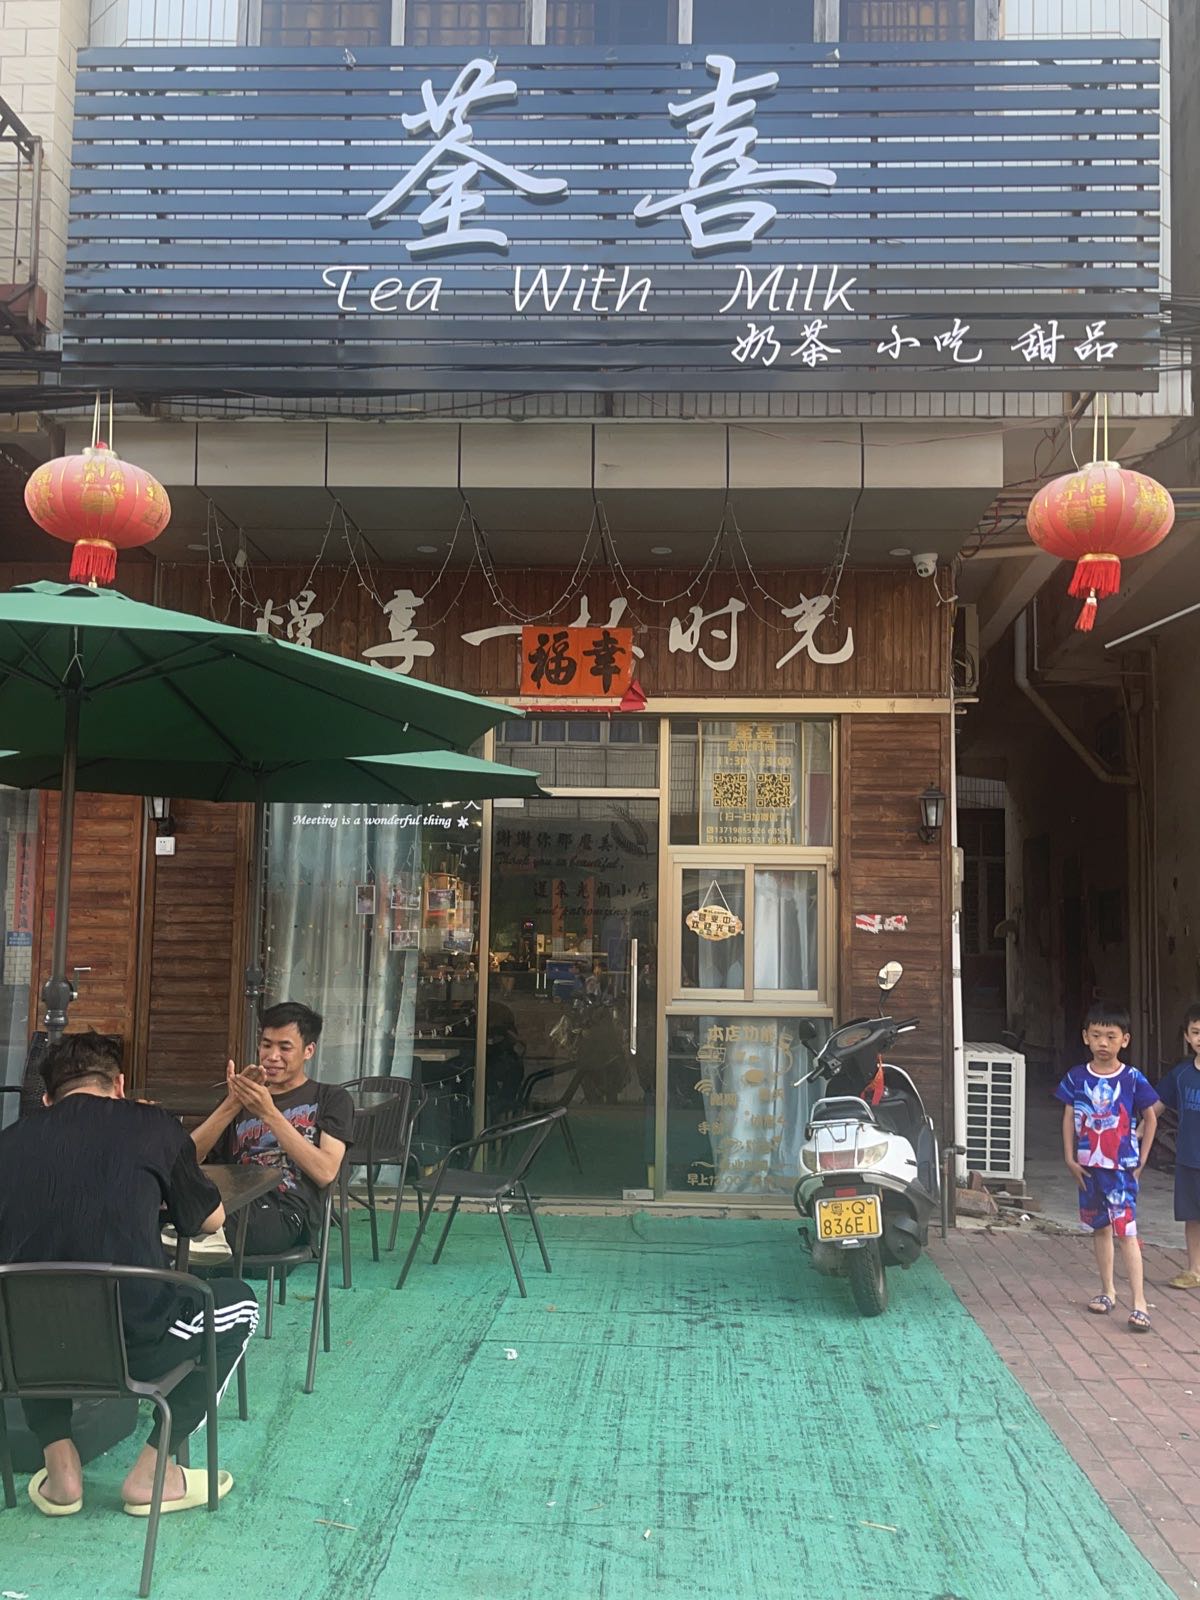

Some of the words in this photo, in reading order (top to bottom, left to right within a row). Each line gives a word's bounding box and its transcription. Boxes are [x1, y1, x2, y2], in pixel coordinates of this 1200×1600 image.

[322, 265, 441, 312] Tea
[515, 263, 652, 312] With
[719, 263, 858, 312] Milk
[731, 319, 841, 367] 奶茶
[877, 319, 982, 363] 小吃
[1010, 320, 1119, 364] 甜品
[257, 588, 854, 675] 慢享一时光
[293, 815, 338, 828] Meeting
[342, 815, 350, 825] is
[354, 817, 361, 825] a
[364, 815, 422, 828] wonderful
[423, 815, 452, 828] thing
